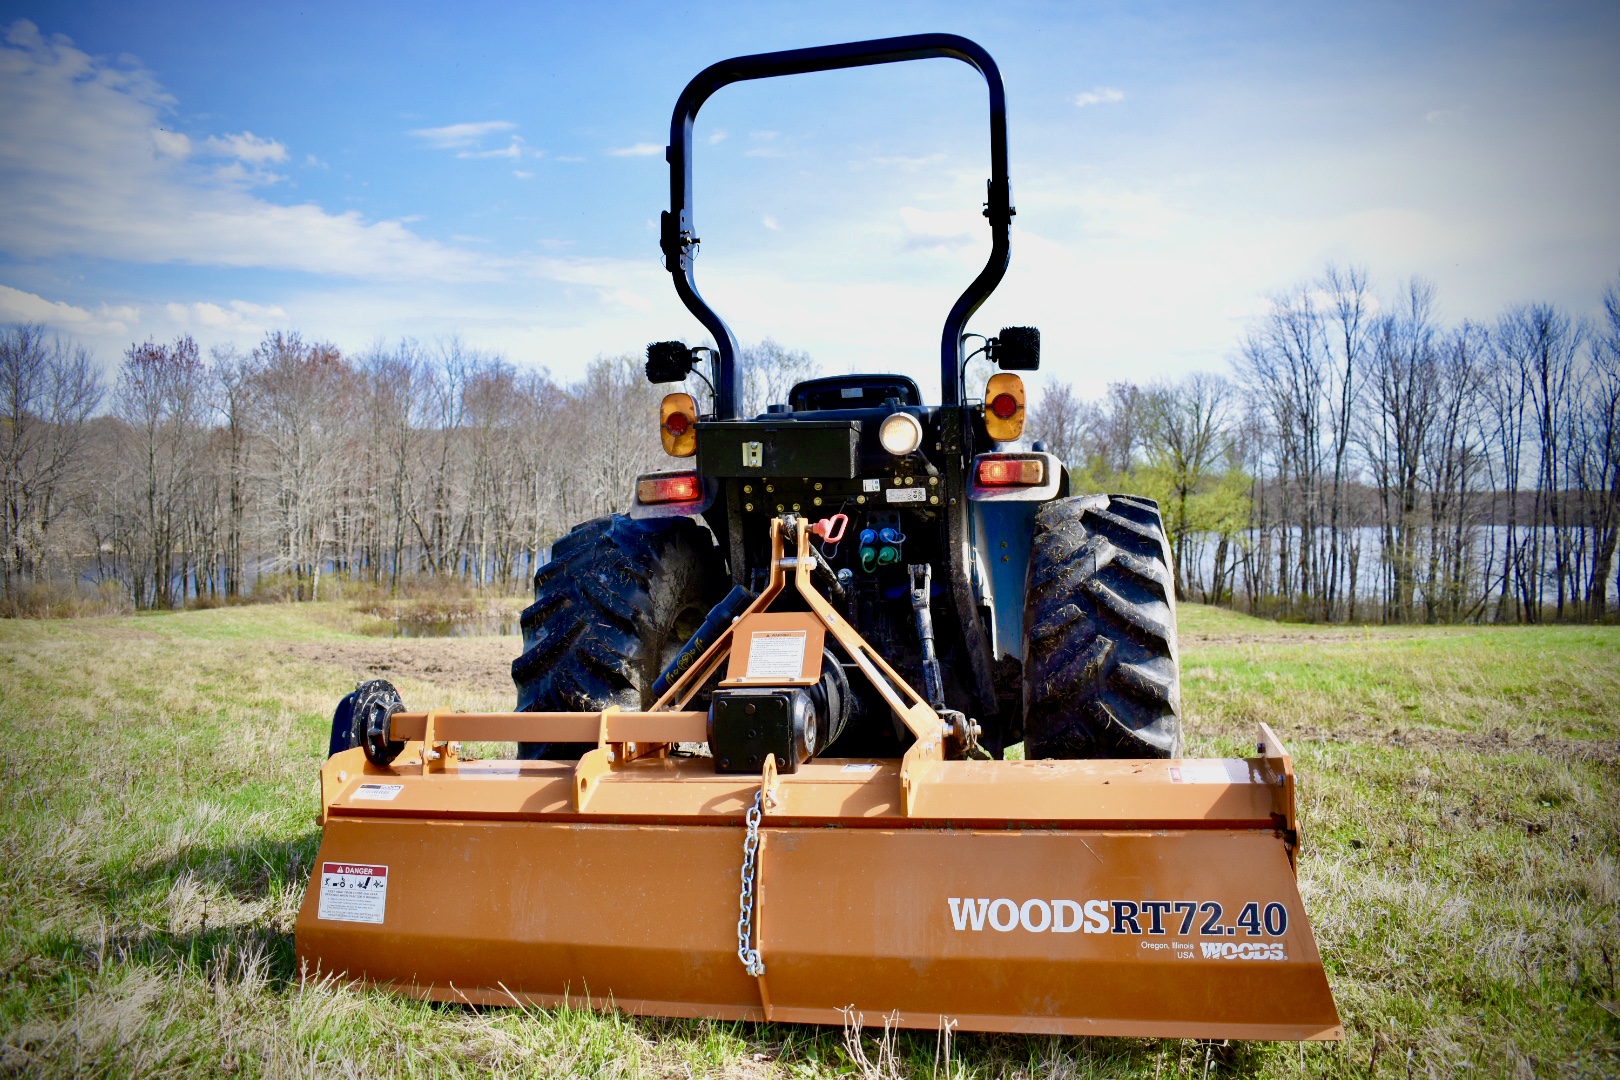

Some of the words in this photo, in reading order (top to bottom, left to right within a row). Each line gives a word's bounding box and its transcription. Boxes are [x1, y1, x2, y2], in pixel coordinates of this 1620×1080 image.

[345, 867, 373, 875] DANGER
[947, 897, 1109, 934] WOODS
[1110, 900, 1288, 937] RT72.40
[1140, 941, 1170, 950] Oregon,
[1172, 942, 1195, 950] Illinois
[1177, 951, 1195, 959] USA
[1199, 942, 1285, 960] WOODS
